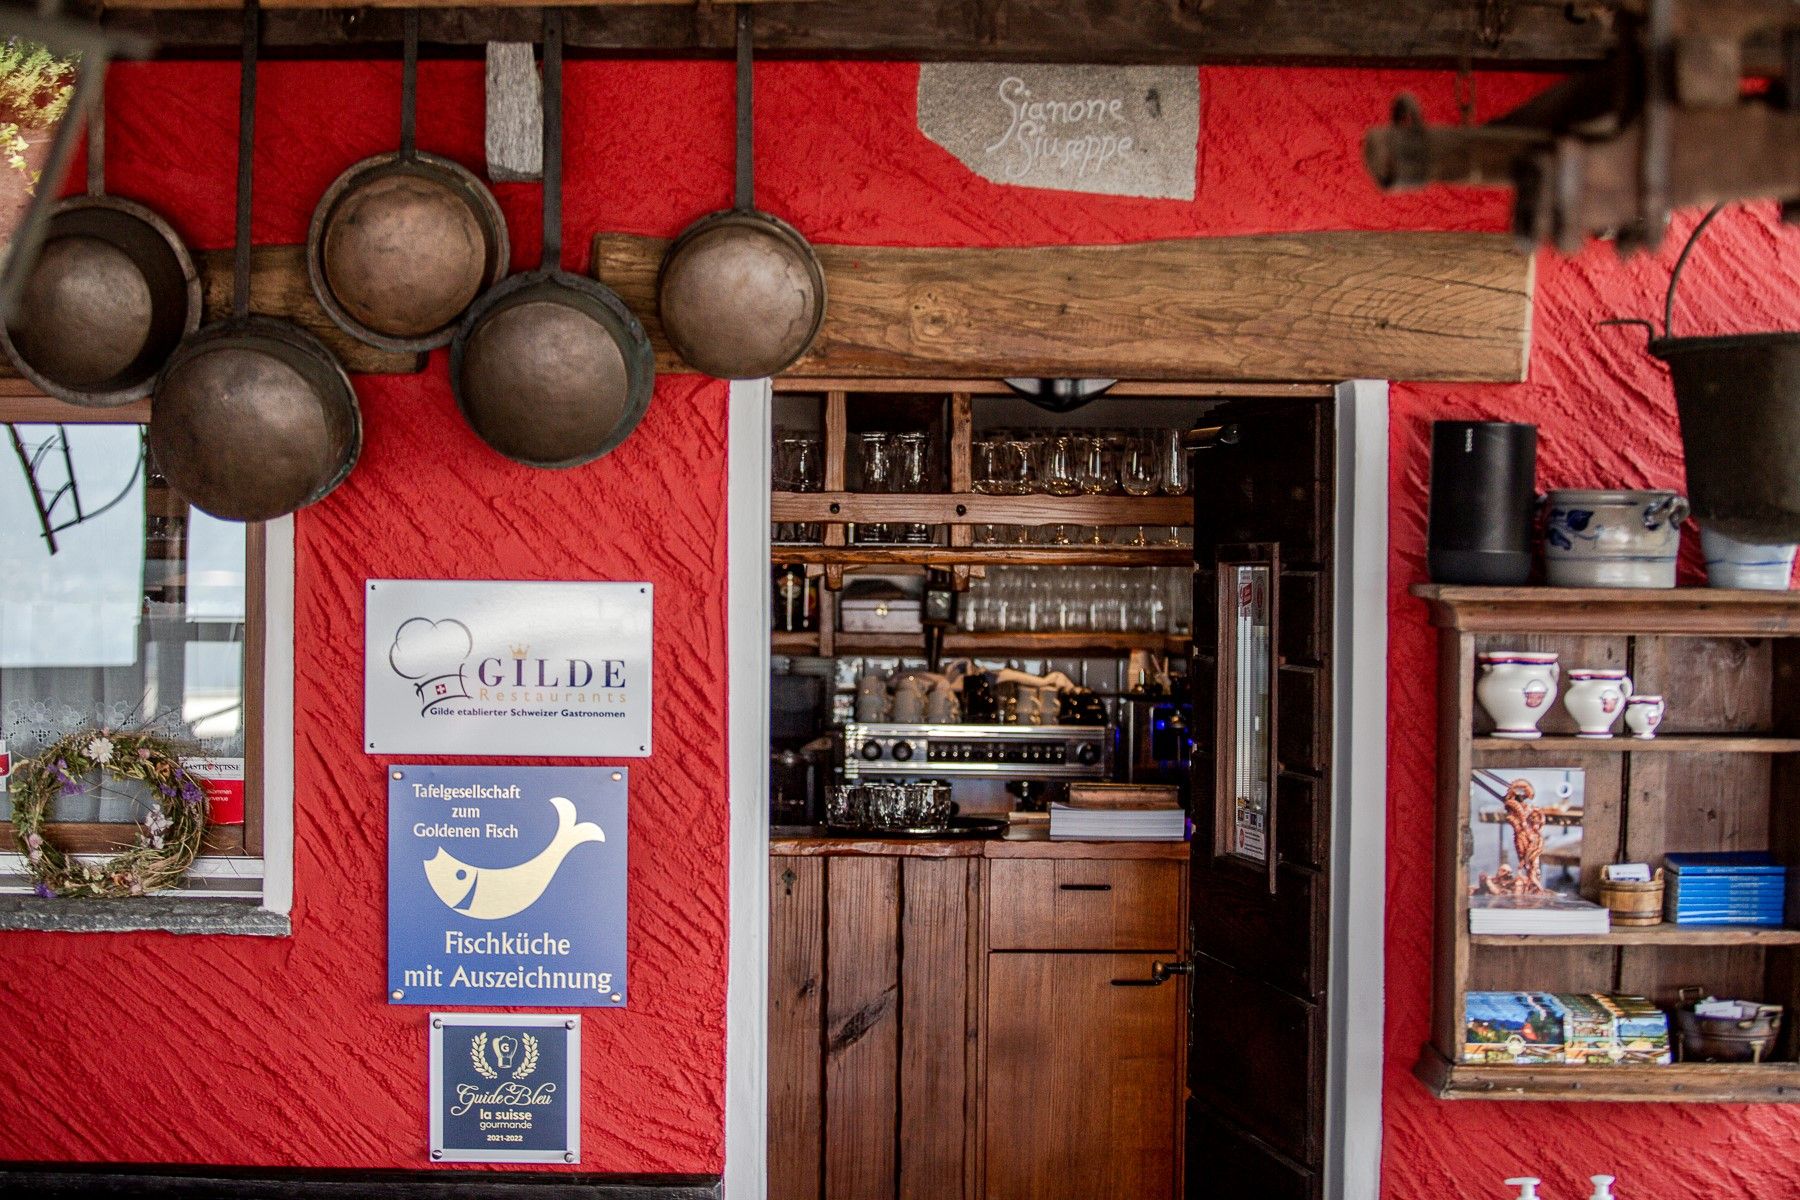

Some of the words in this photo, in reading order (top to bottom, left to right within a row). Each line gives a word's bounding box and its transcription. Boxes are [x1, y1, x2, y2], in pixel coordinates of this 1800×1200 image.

[478, 657, 626, 688] GILDE
[480, 688, 627, 703] Restaurants
[430, 707, 455, 716] Gilde
[457, 707, 508, 717] etablierter
[510, 708, 558, 718] Schweizer
[561, 709, 626, 718] Gastronomen
[412, 783, 522, 800] Tafelgesellschaft
[452, 807, 480, 818] zum
[413, 823, 480, 838] Goldenen
[485, 824, 519, 839] Fisch
[445, 931, 571, 955] Fischküche
[404, 965, 442, 987] mit
[450, 965, 612, 994] Auszeichnung
[501, 1043, 510, 1052] G
[451, 1082, 510, 1116] Guide
[505, 1083, 556, 1106] Bleu
[480, 1108, 491, 1120] la
[496, 1109, 532, 1120] suisse
[480, 1120, 532, 1131] gourmande
[486, 1134, 523, 1142] 2021-2022
